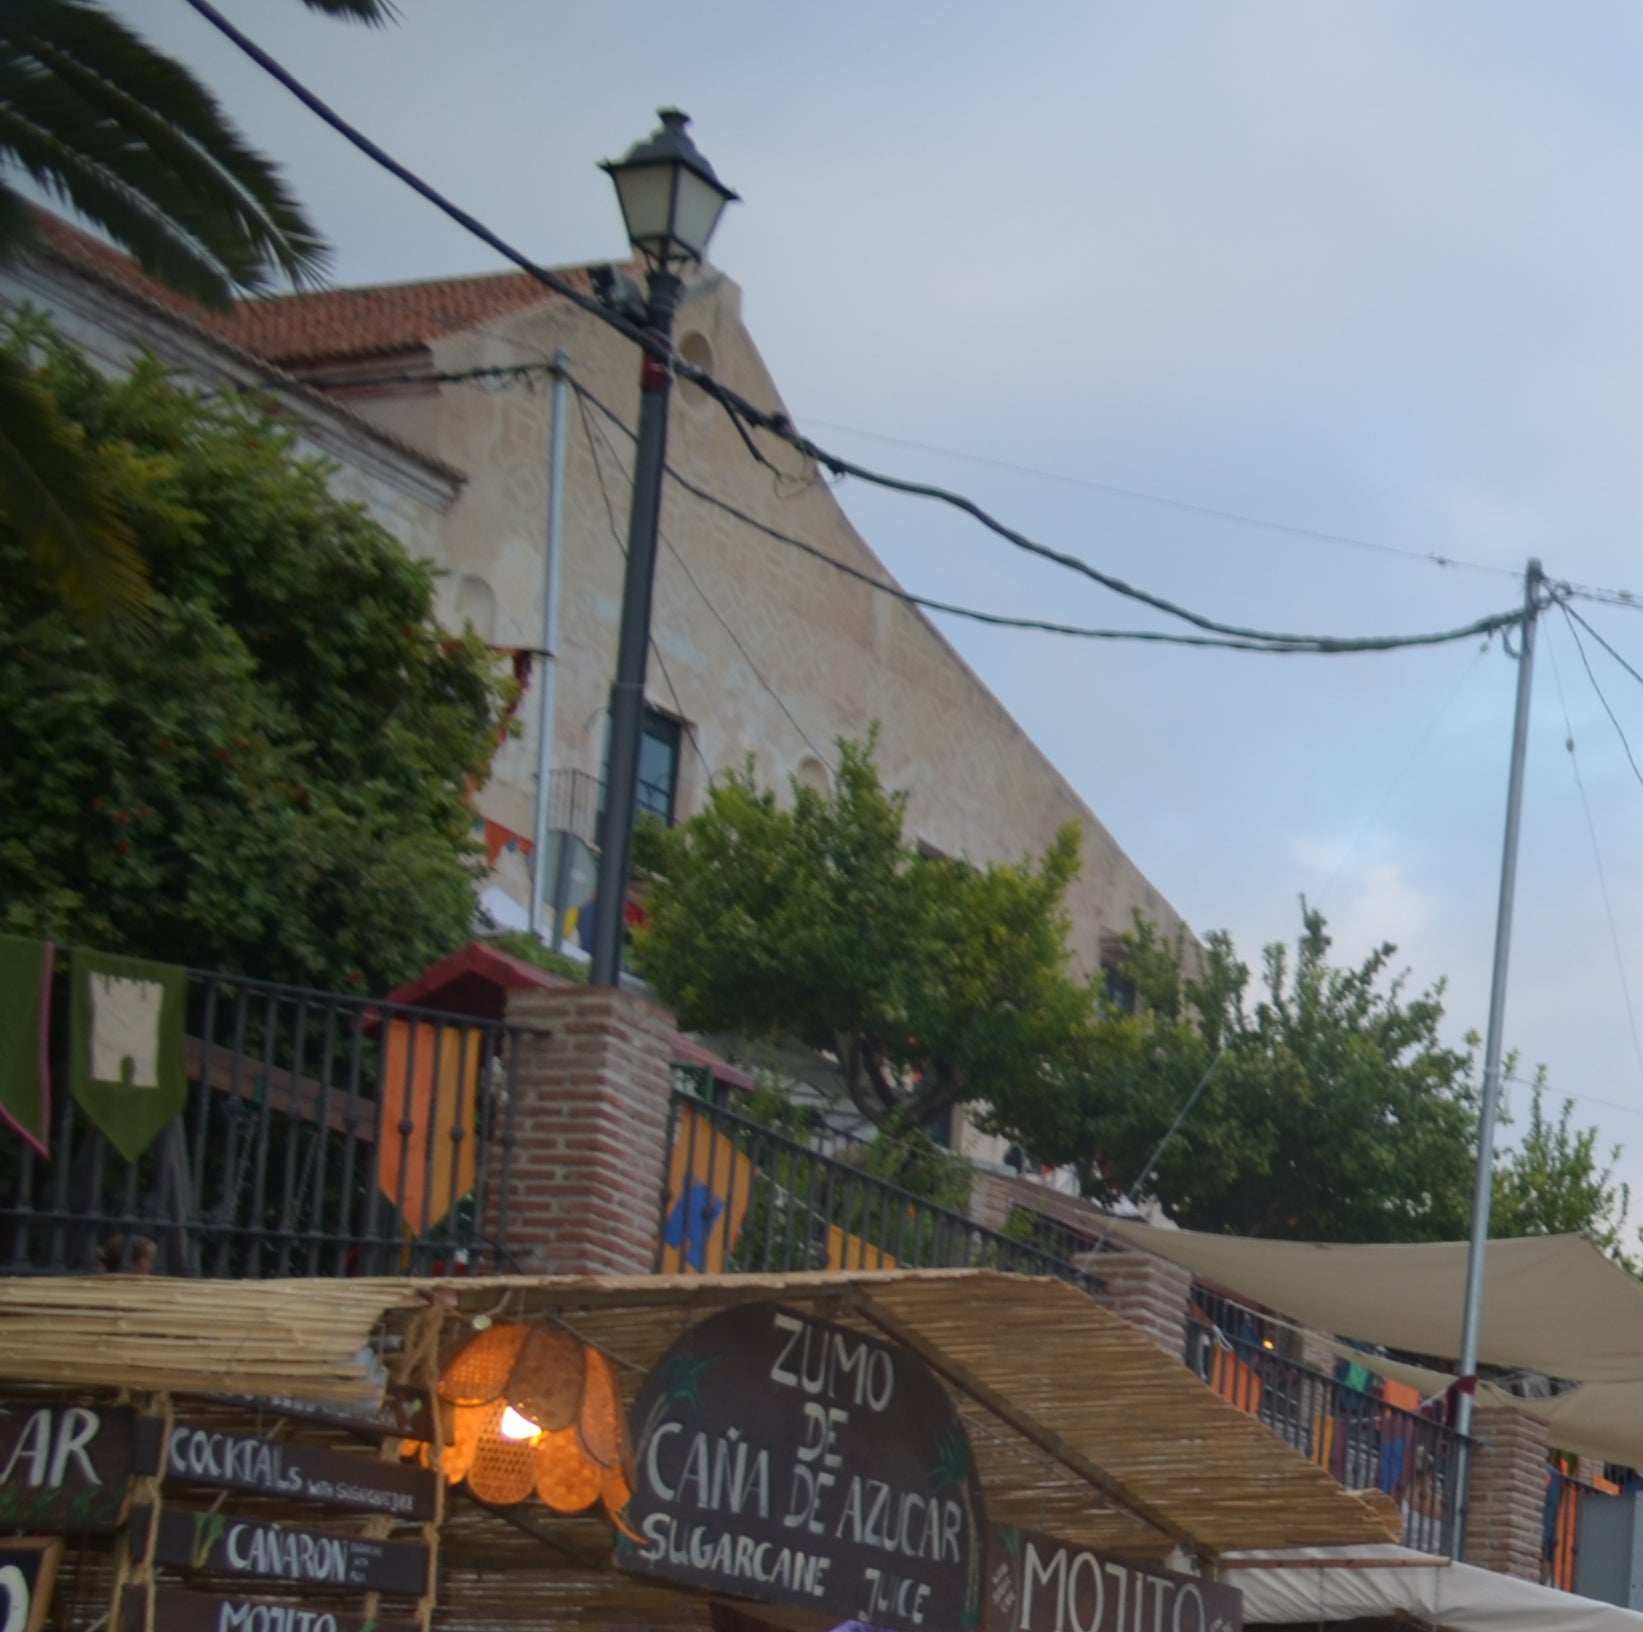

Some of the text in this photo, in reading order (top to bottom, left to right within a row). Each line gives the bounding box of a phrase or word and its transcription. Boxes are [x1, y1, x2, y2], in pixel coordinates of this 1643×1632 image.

[770, 1313, 895, 1412] ZUMO
[0, 1407, 102, 1487] AR
[798, 1402, 849, 1468] DE
[646, 1421, 963, 1564] CAÑA DE AZUCAR
[639, 1512, 832, 1597] SUGARCANE
[858, 1567, 932, 1624] JUICE
